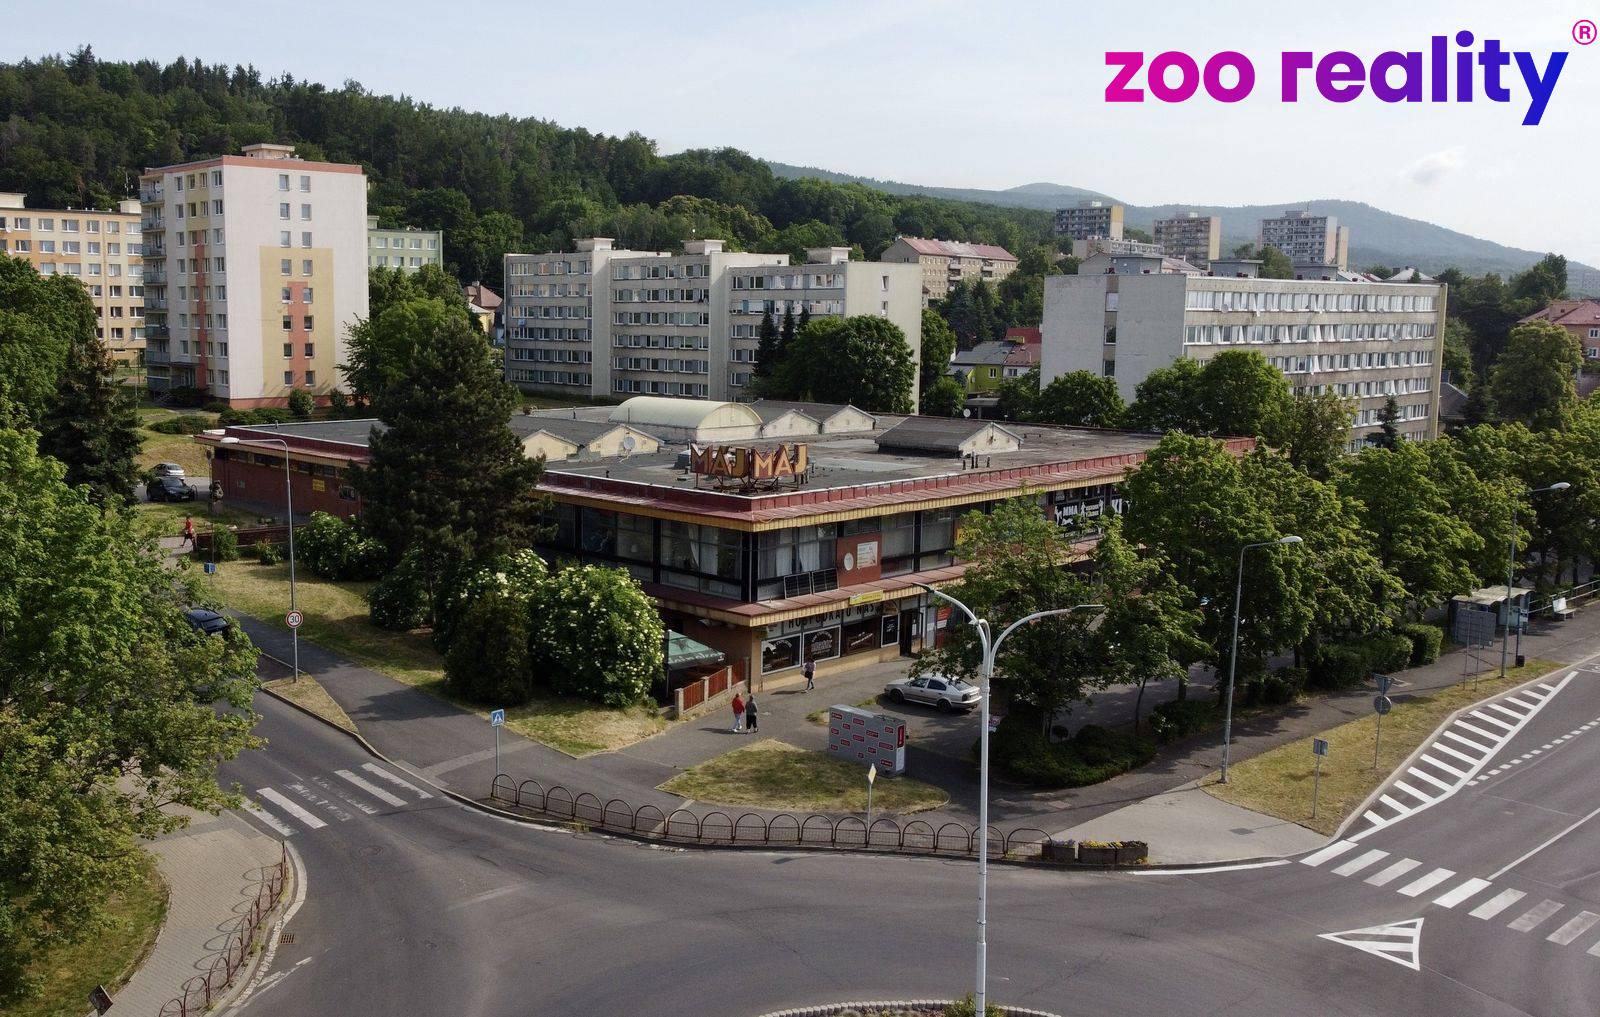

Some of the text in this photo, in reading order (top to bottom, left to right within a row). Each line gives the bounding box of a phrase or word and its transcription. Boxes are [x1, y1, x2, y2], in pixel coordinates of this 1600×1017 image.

[690, 443, 748, 478] MAJ
[752, 442, 808, 478] MAJ
[289, 614, 300, 623] 30
